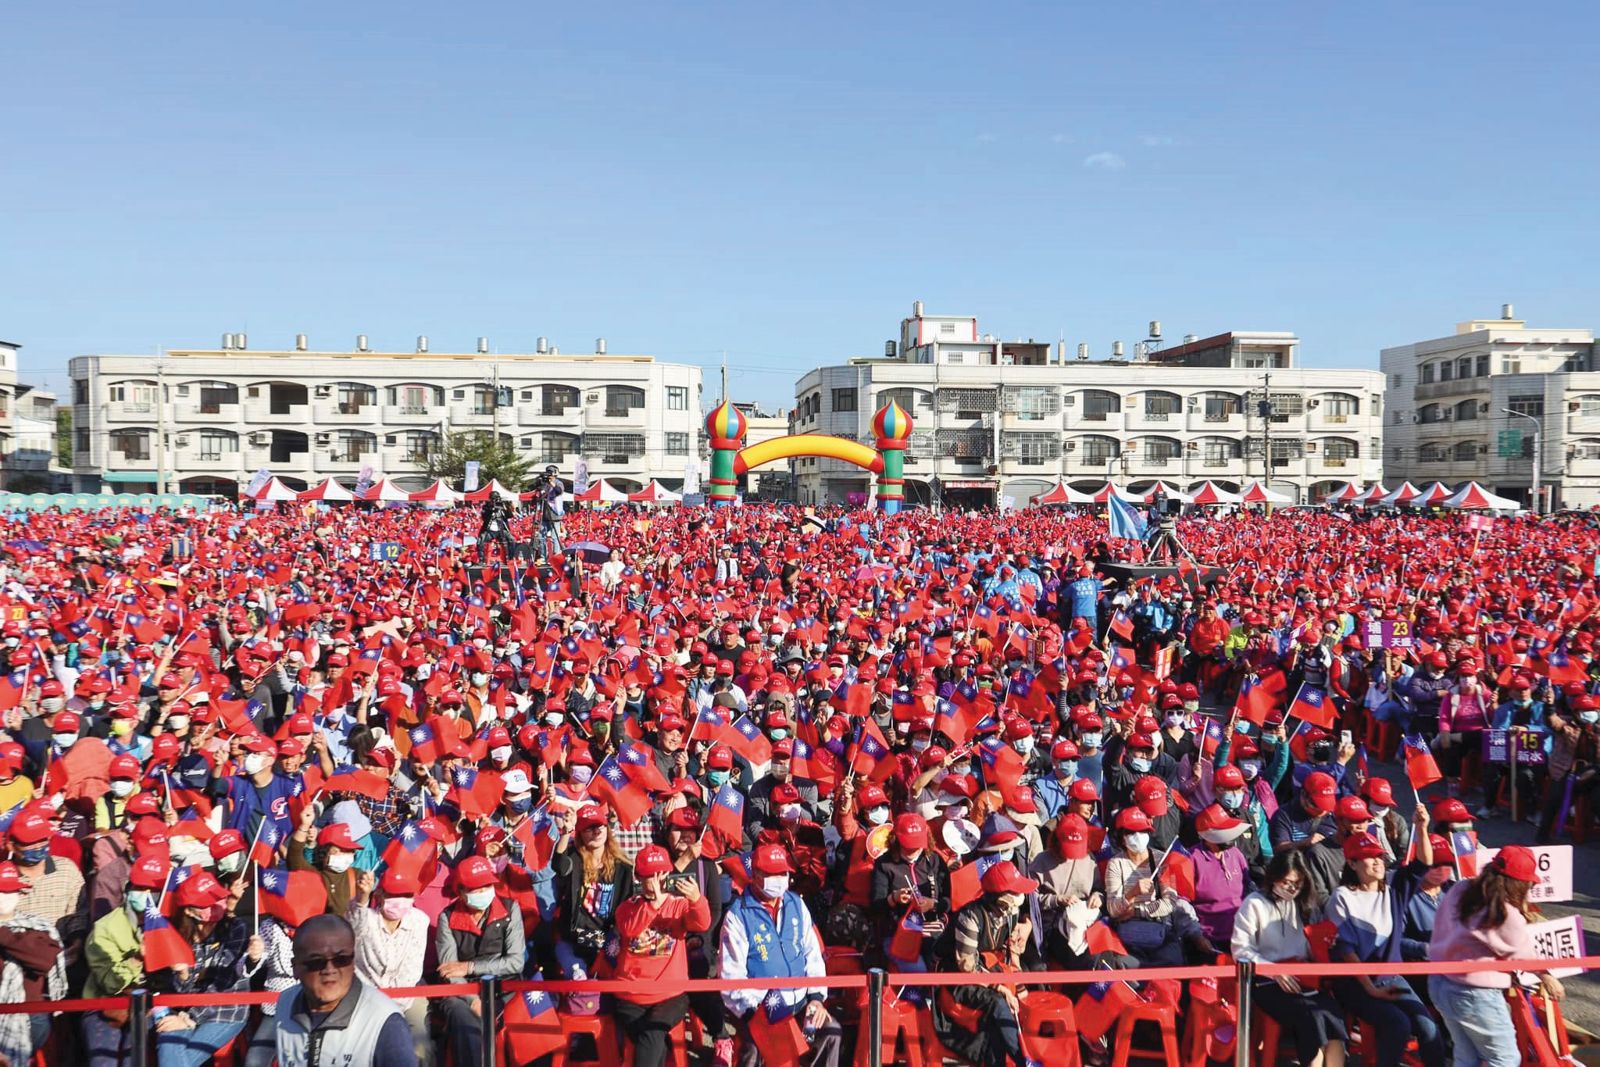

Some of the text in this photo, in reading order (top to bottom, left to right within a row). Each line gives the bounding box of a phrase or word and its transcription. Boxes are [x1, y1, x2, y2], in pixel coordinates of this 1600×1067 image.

[386, 545, 398, 558] 12
[1392, 621, 1409, 636] 23
[1520, 733, 1539, 750] 15
[1538, 852, 1551, 872] 6
